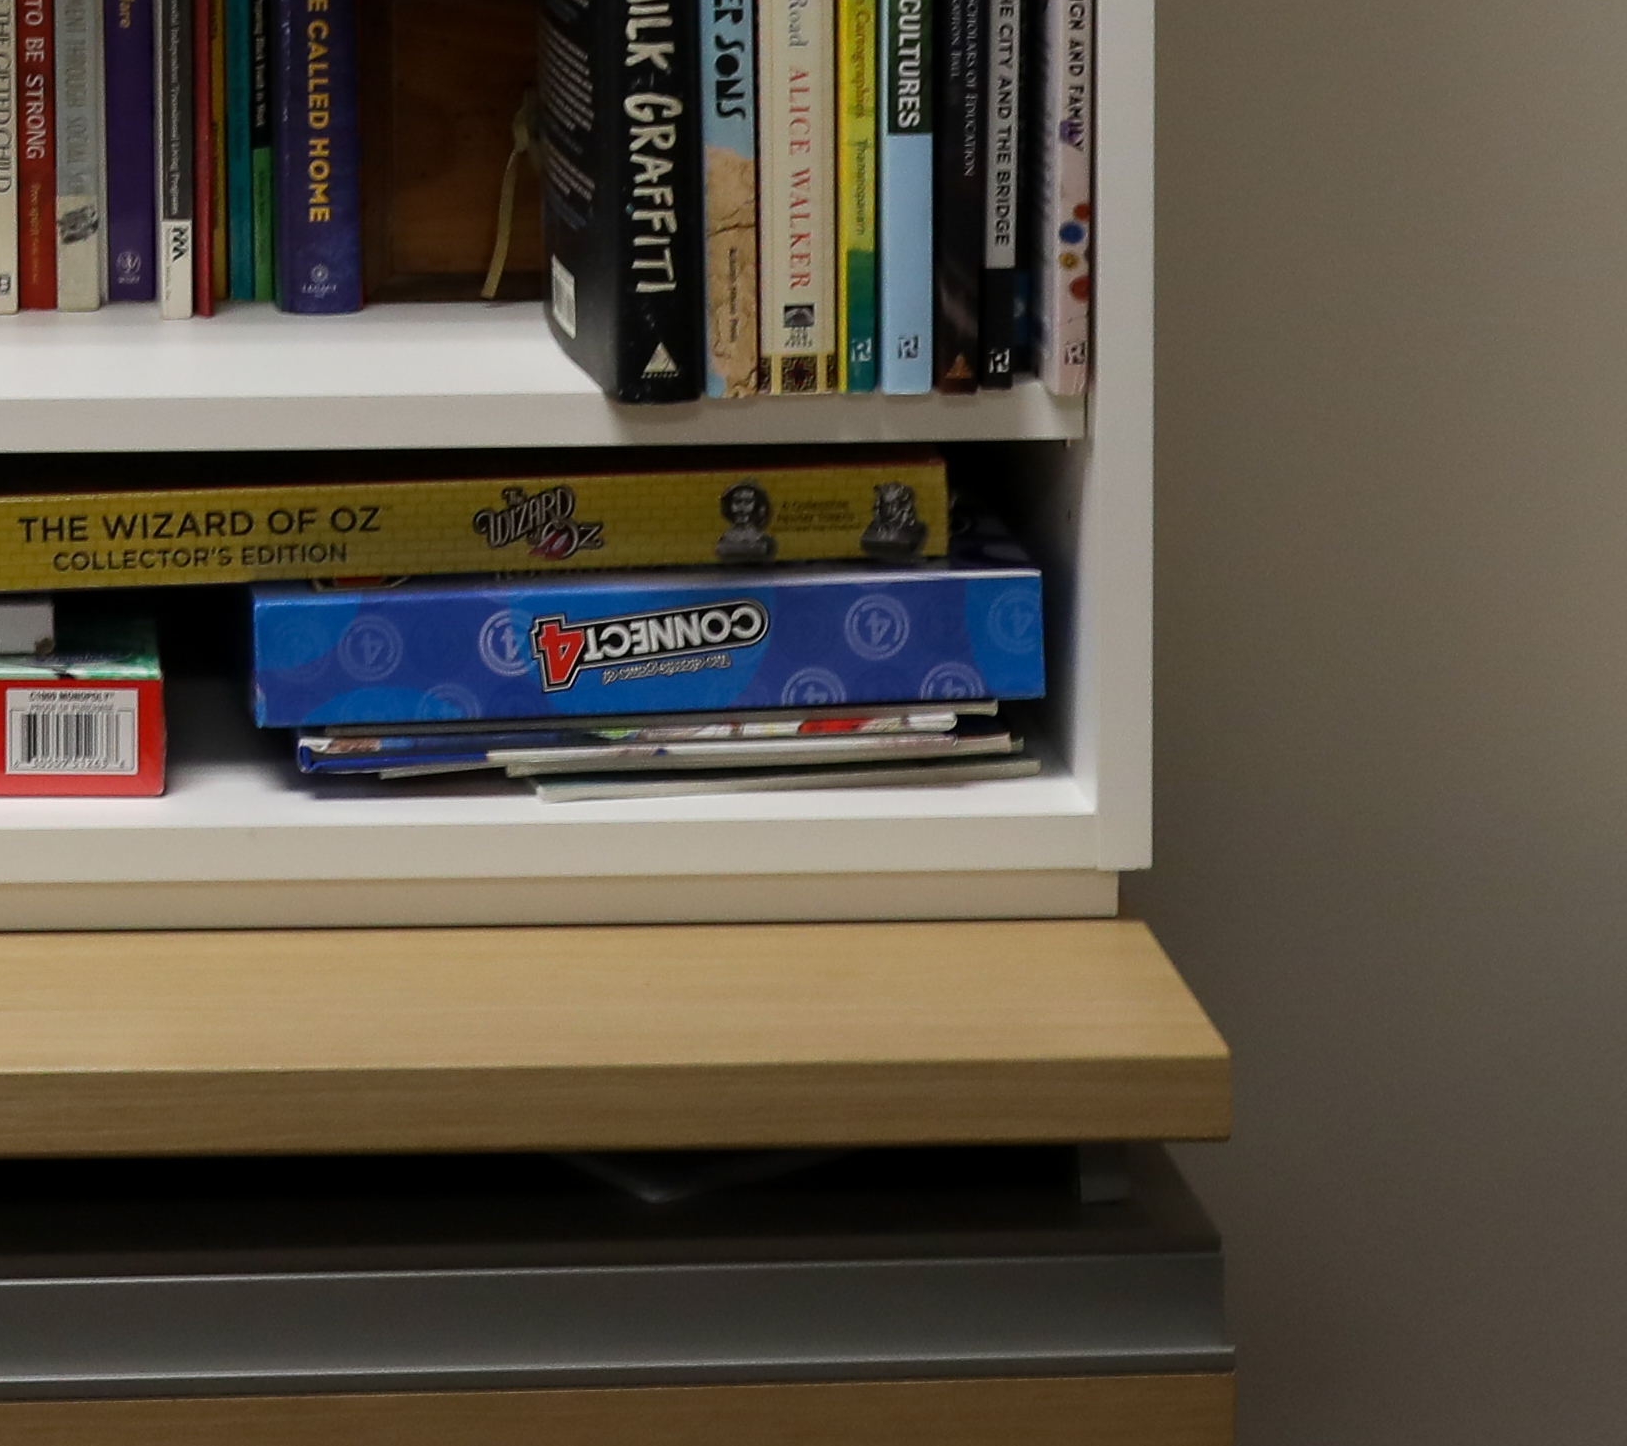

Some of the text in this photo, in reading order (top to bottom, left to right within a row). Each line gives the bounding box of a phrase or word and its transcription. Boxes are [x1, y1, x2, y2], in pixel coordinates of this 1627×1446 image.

[25, 37, 44, 63] BE
[307, 19, 330, 130] CALLED
[715, 35, 746, 120] SONS
[1000, 25, 1012, 69] CITY
[25, 74, 45, 159] STRONG
[998, 78, 1011, 120] AND
[997, 126, 1011, 169] THE
[307, 138, 330, 222] HOME
[623, 91, 683, 293] GRAFFITI
[789, 68, 812, 290] ALICE WALKER
[996, 172, 1009, 247] BRIDGE
[18, 506, 381, 543] THE WIZARD OF OZ
[473, 485, 576, 547] WIZARD
[53, 543, 347, 572] COLLECTOR'S EDITION
[539, 623, 586, 686] 4
[582, 605, 763, 661] CONNECT
